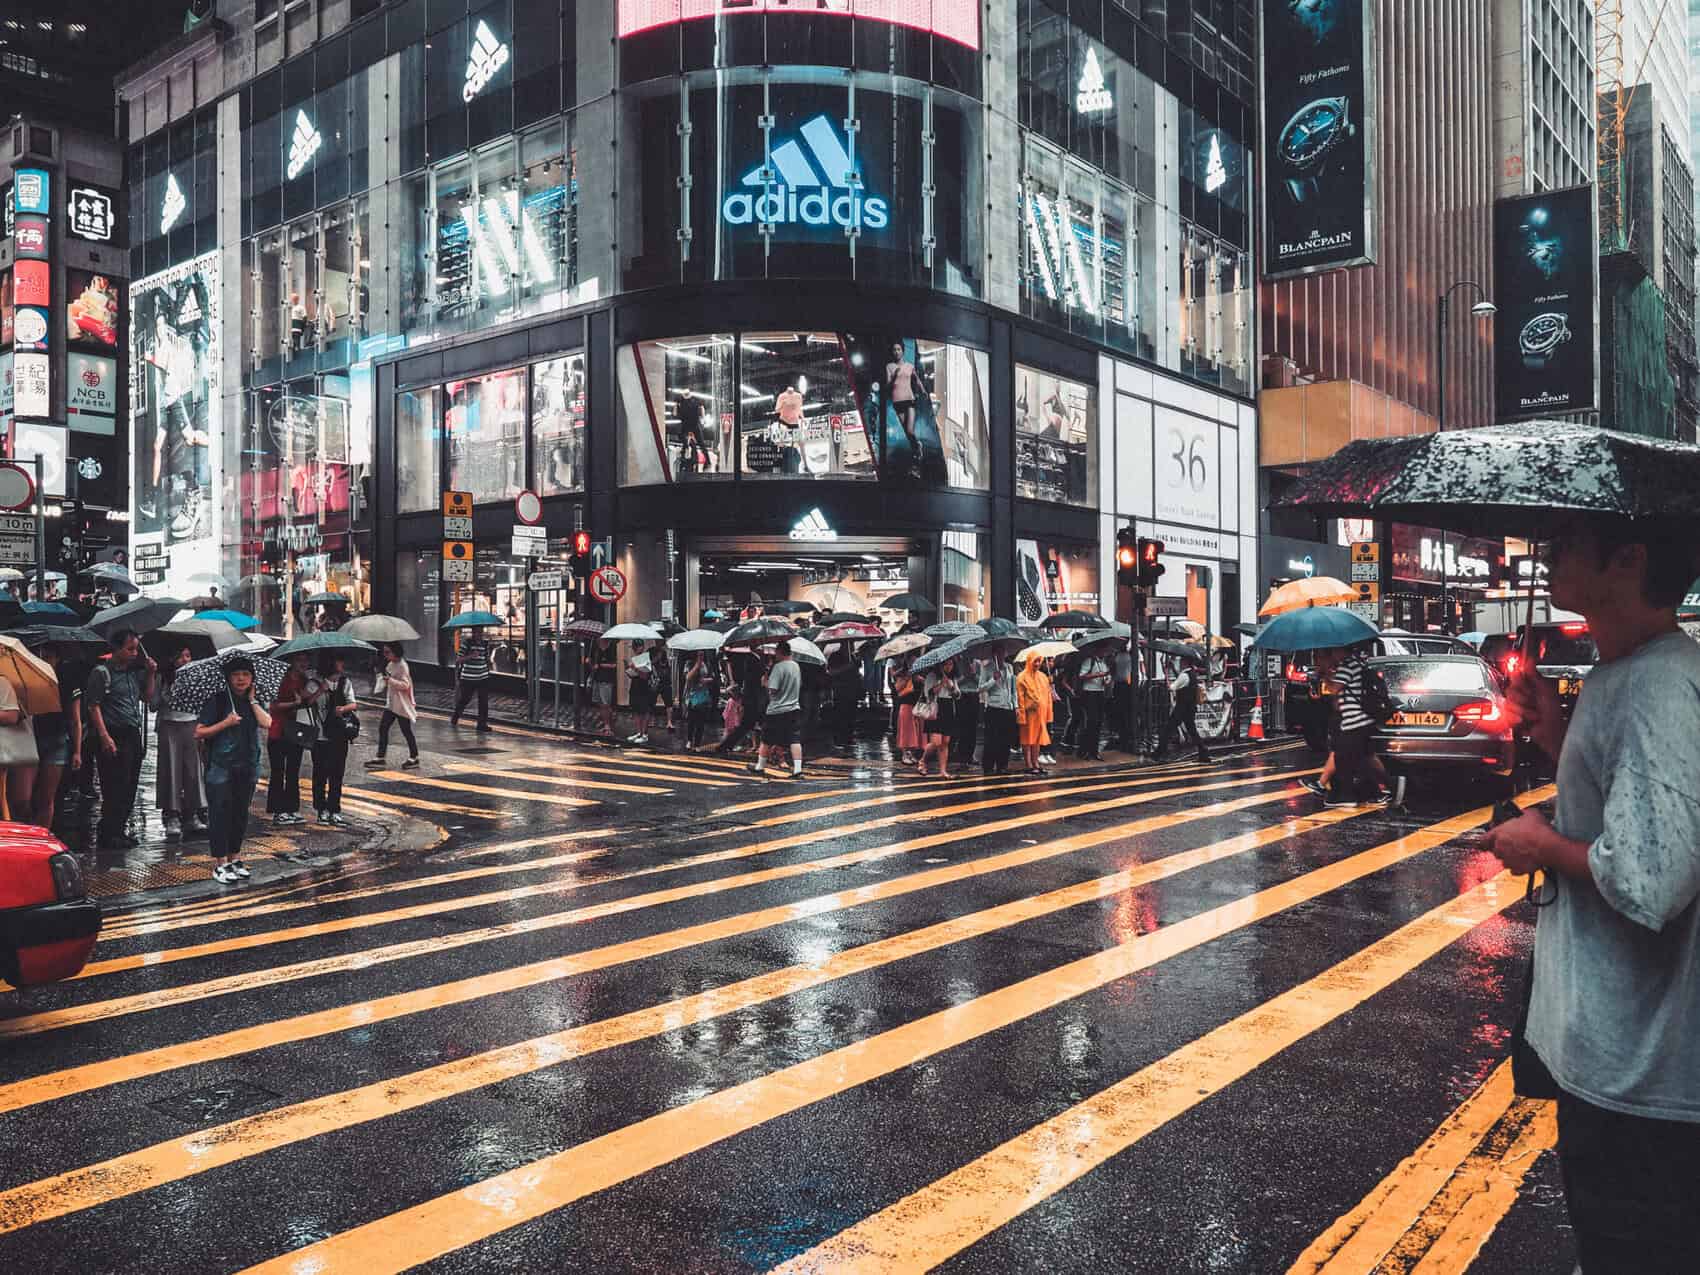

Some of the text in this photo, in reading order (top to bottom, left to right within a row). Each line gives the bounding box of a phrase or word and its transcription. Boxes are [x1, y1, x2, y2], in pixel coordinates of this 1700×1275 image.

[723, 185, 887, 228] adidas
[1280, 231, 1351, 254] BLANCPAIN
[77, 387, 106, 400] NCB
[1168, 427, 1206, 494] 36
[6, 519, 33, 529] 10 m
[1414, 713, 1440, 724] 1146
